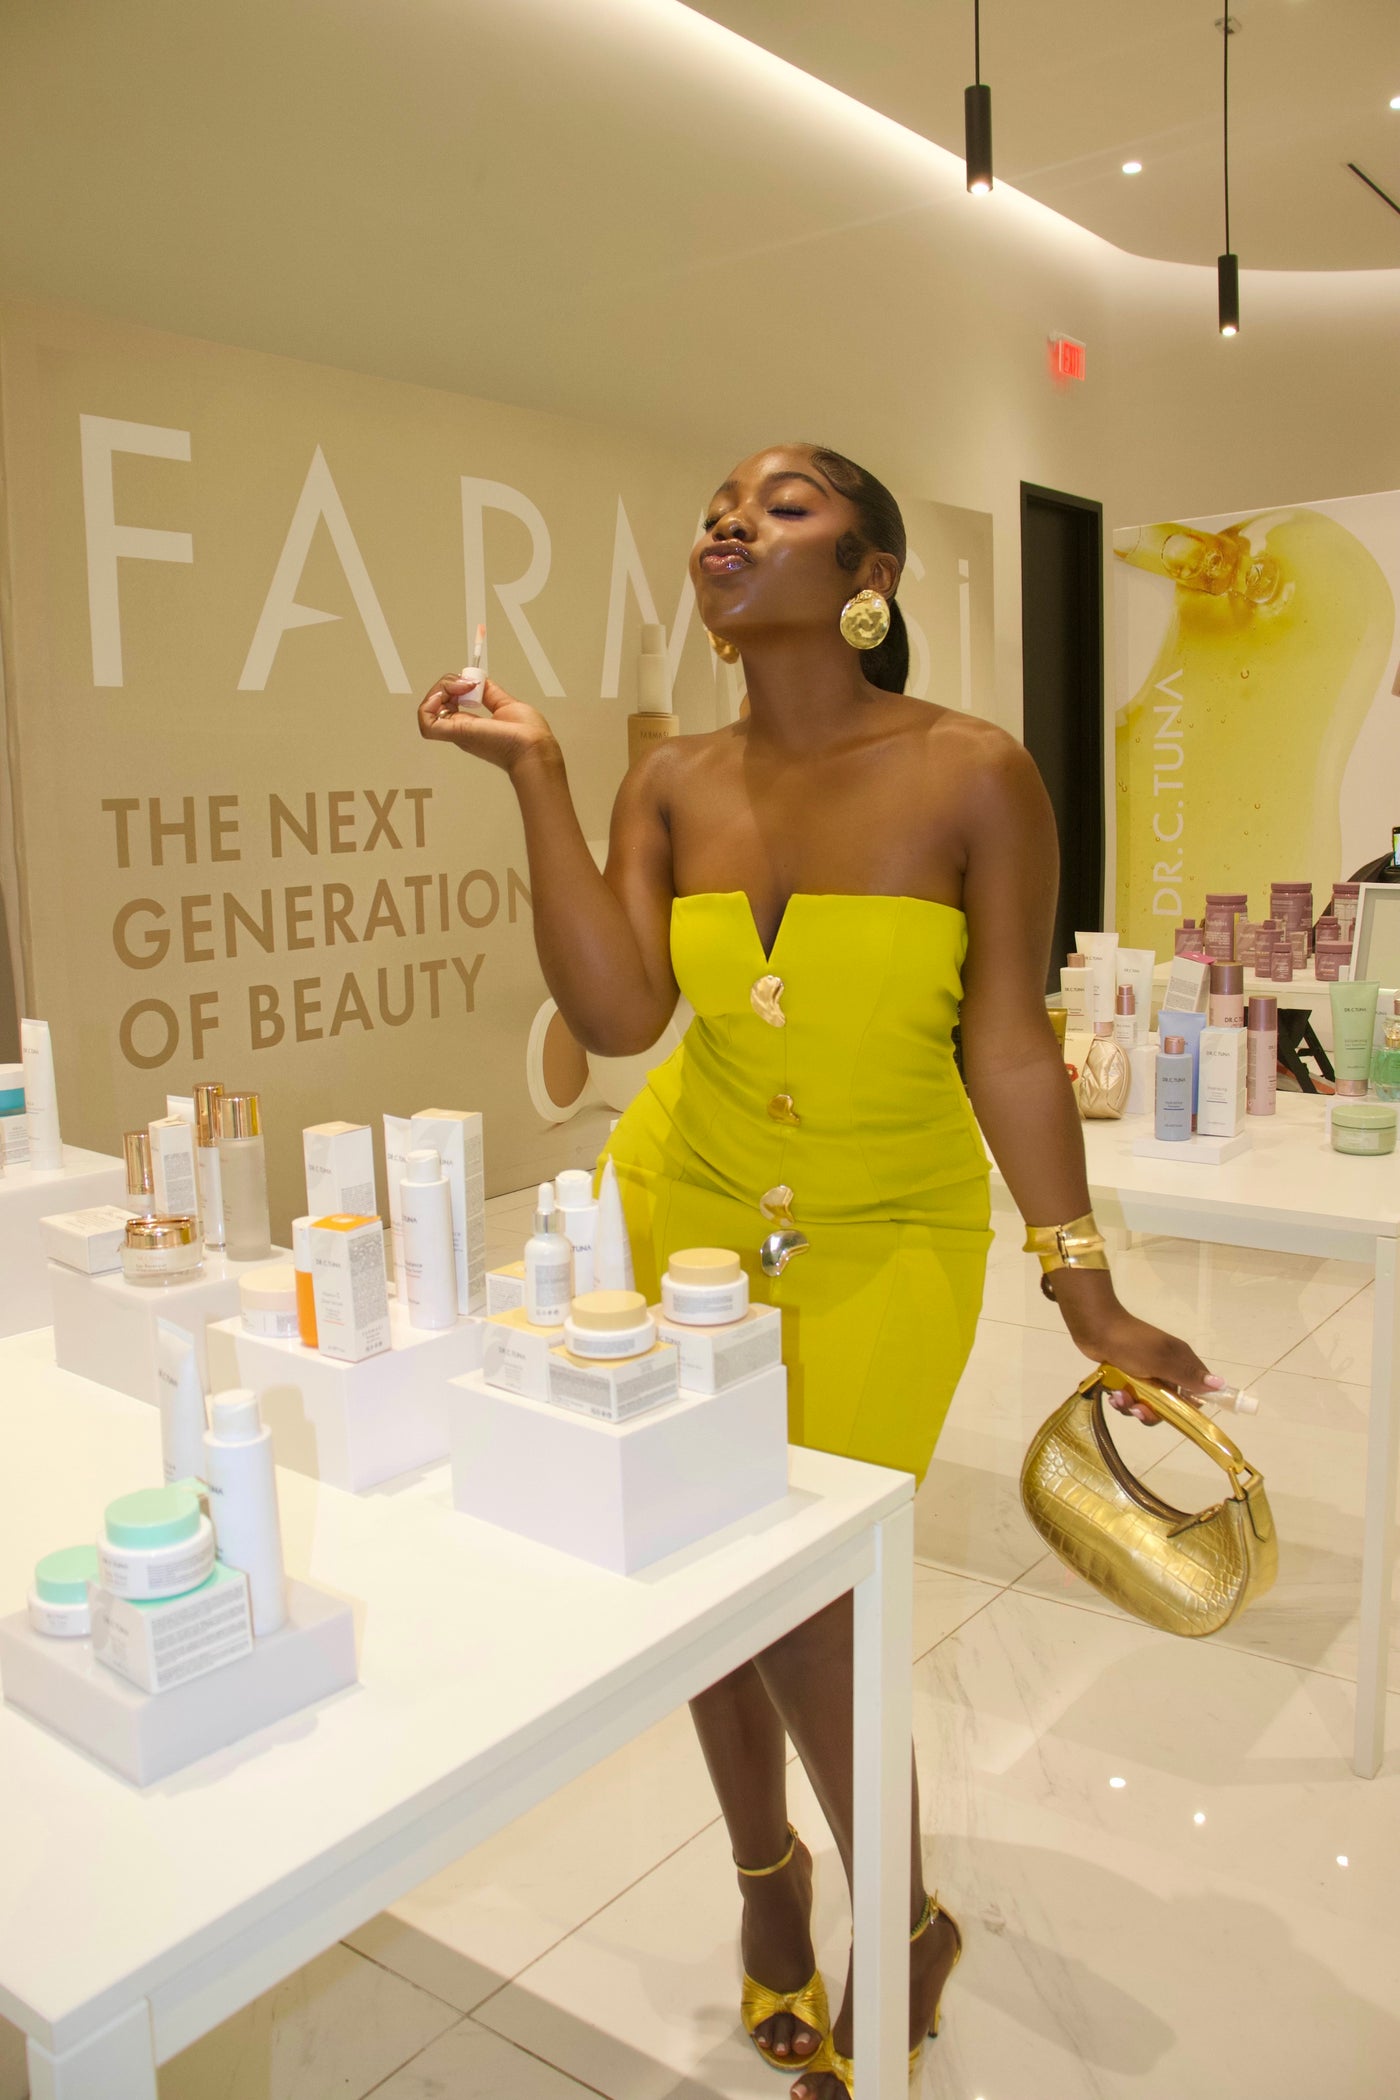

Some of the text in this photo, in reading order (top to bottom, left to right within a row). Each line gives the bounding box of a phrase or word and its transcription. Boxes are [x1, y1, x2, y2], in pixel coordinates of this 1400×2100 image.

[102, 788, 434, 869] THE NEXT
[112, 867, 534, 971] GENERATION
[118, 953, 487, 1070] OF BEAUTY
